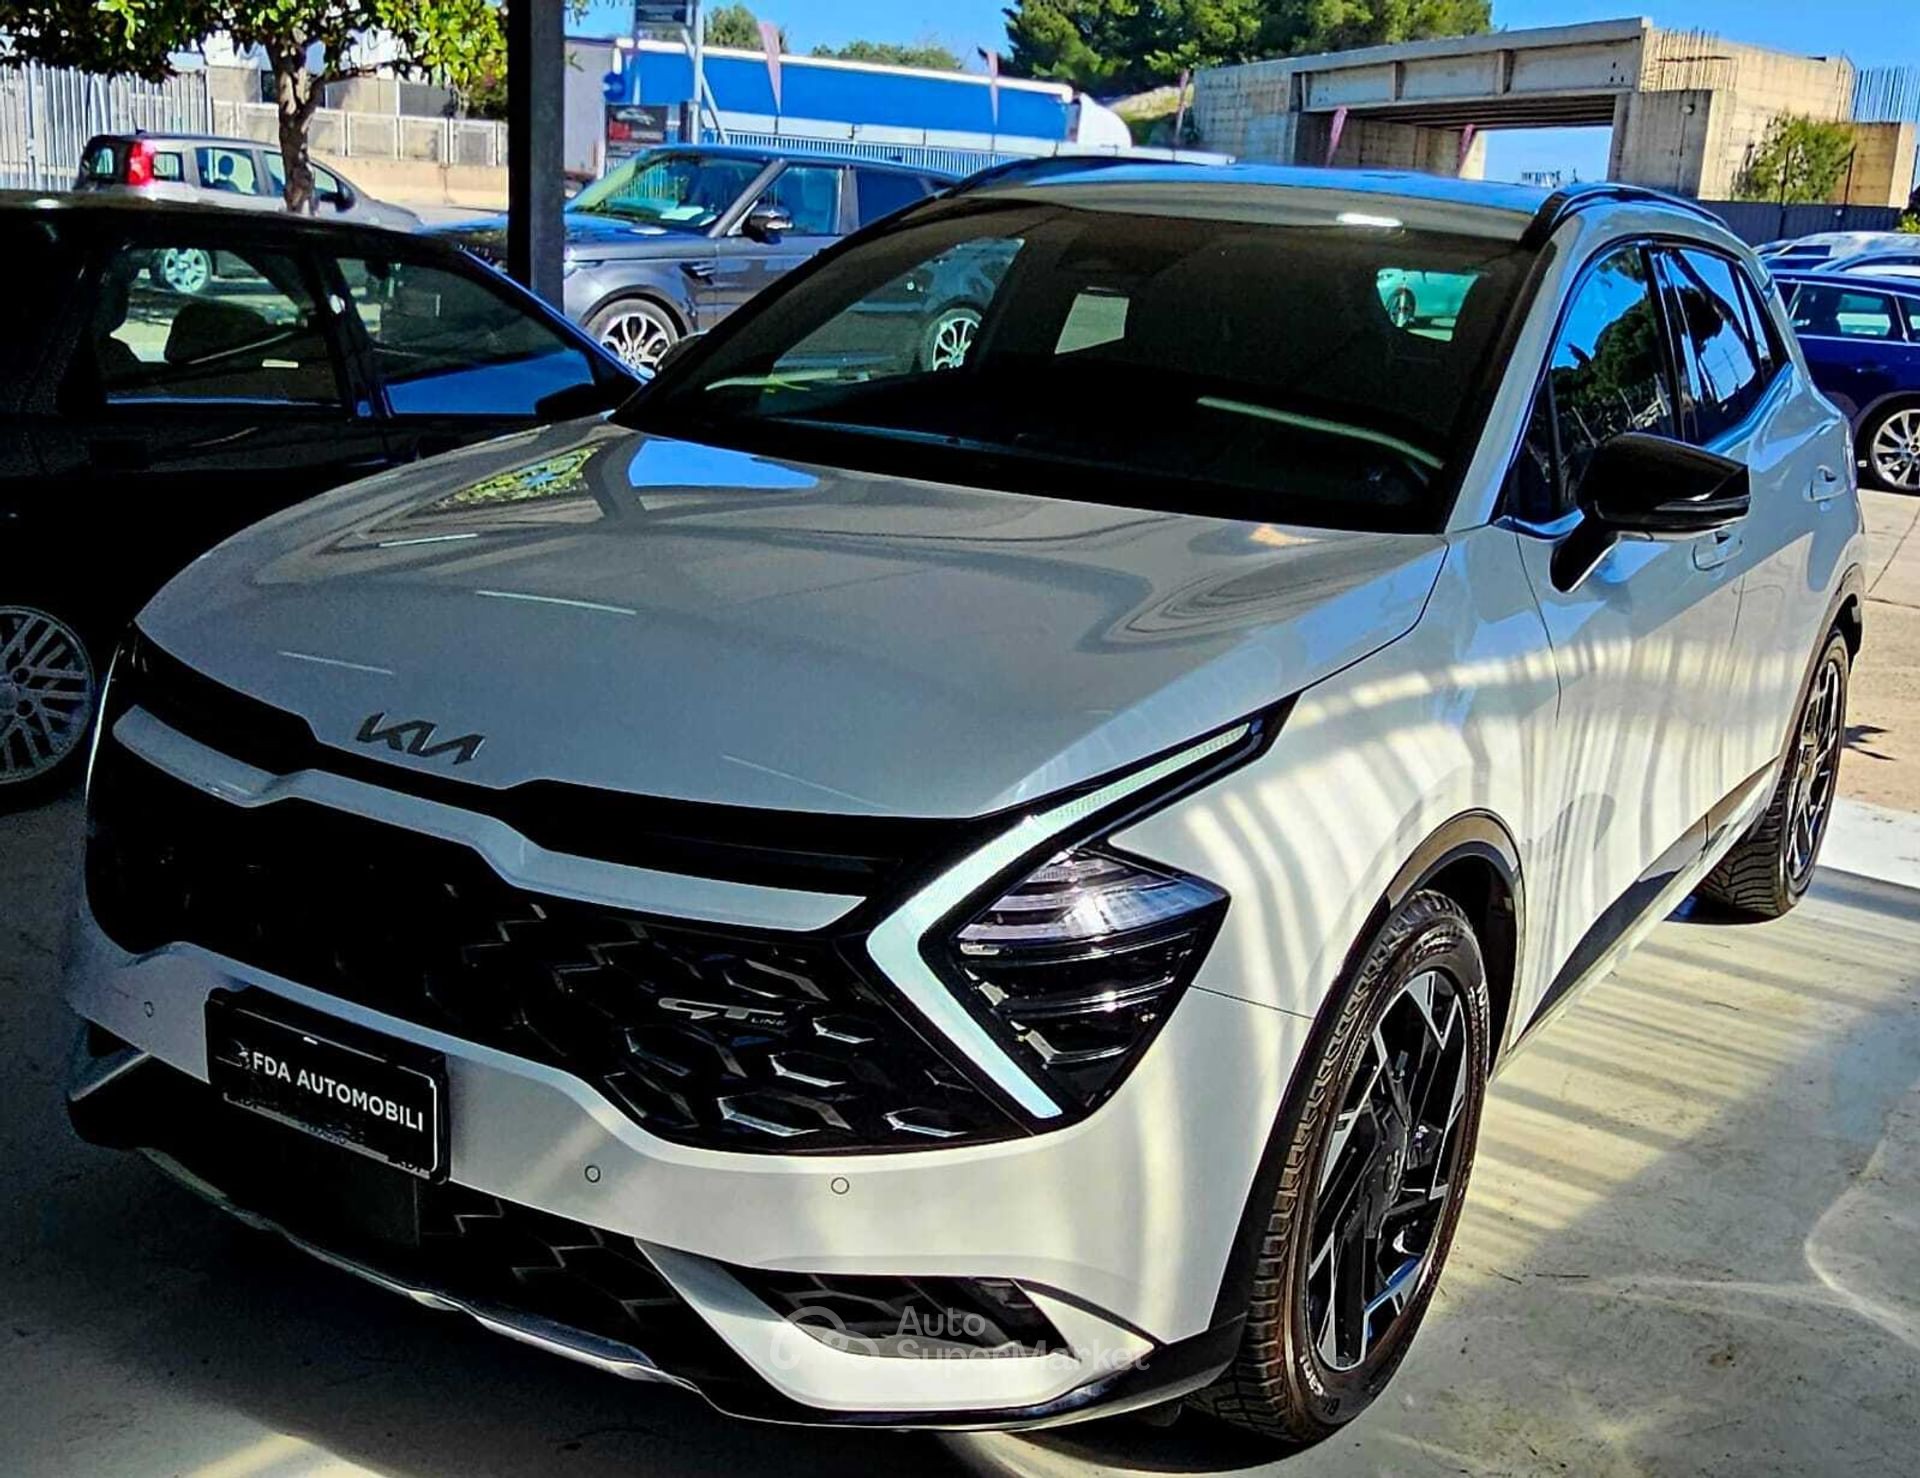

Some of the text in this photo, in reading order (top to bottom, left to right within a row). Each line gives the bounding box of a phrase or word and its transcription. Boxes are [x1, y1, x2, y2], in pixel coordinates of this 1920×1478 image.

[356, 711, 486, 766] KIA
[252, 1051, 424, 1133] FDA AUTOMOBILI
